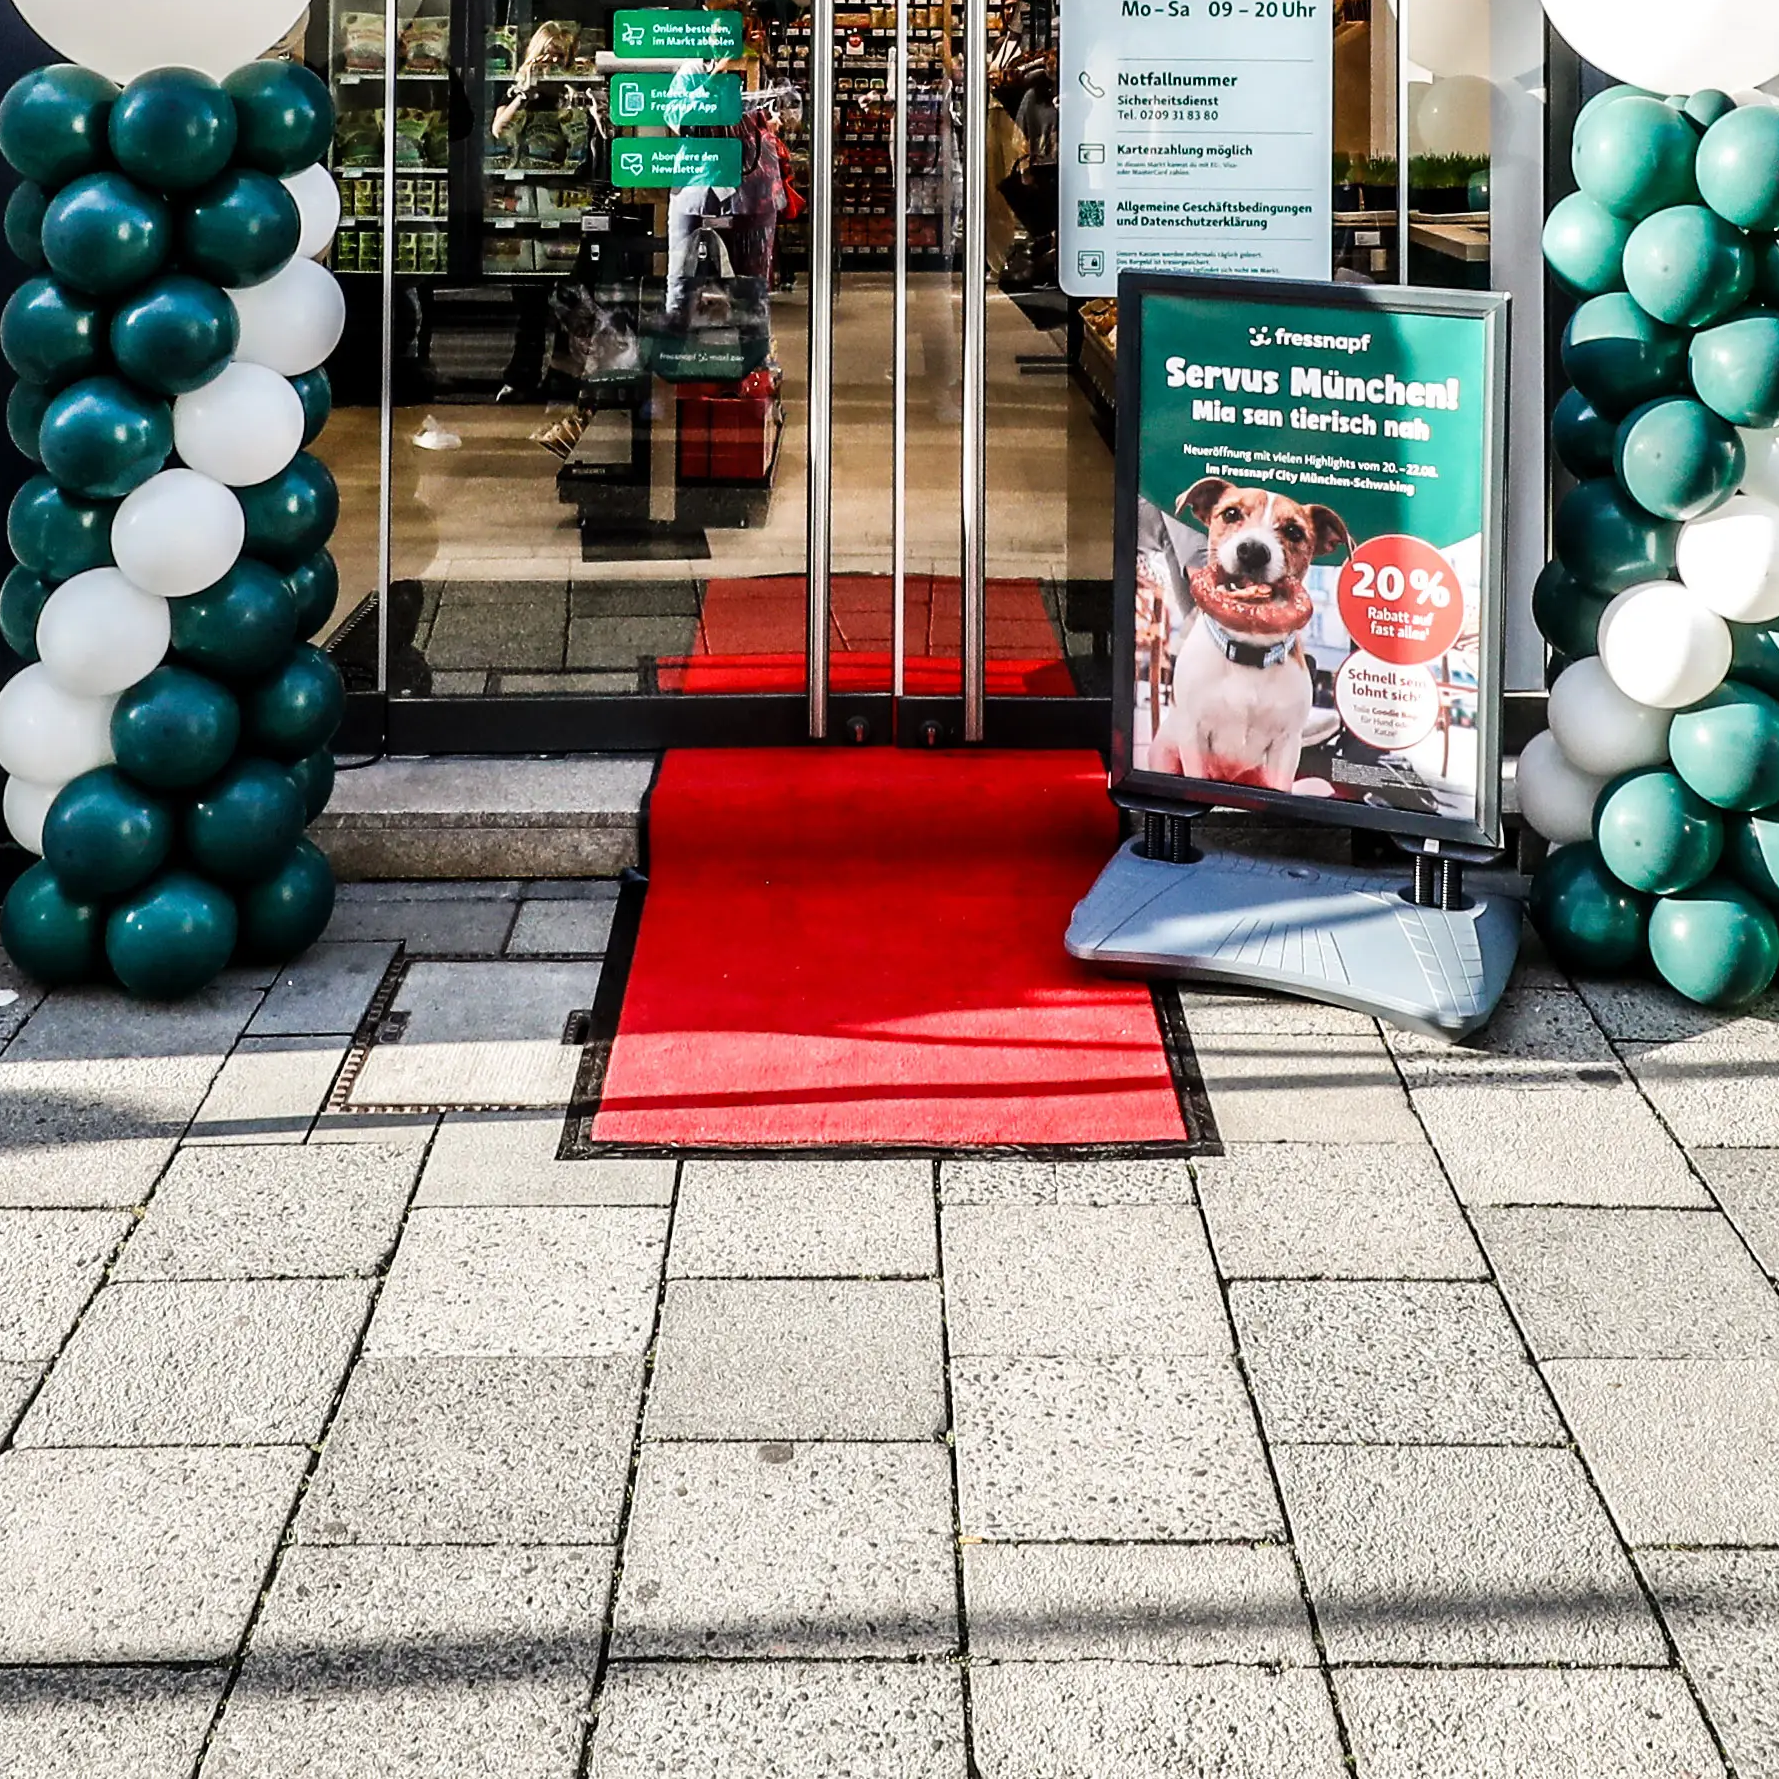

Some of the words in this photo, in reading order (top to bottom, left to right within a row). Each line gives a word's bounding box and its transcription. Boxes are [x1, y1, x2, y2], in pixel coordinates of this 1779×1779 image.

[1121, 0, 1152, 18] Mo
[1168, 0, 1190, 18] Sa
[1208, 0, 1233, 18] 09
[1254, 0, 1278, 18] 20
[1282, 0, 1317, 18] Uhr
[652, 23, 684, 34] Online
[652, 36, 665, 46] im
[666, 36, 695, 46] Markt
[1118, 72, 1239, 87] Notfallnummer
[698, 102, 717, 113] App
[1118, 94, 1219, 106] Sicherheitsdienst
[1118, 109, 1137, 121] Tel.
[1140, 109, 1169, 121] 0209
[1172, 109, 1184, 121] 31
[1187, 109, 1201, 121] 83
[1203, 109, 1219, 121] 80
[702, 151, 719, 162] den
[1117, 144, 1204, 159] Kartenzahlung
[1206, 144, 1253, 159] möglich
[1117, 202, 1180, 216] Allgemeine
[1182, 202, 1312, 216] Geschäftsbedingungen
[1117, 216, 1138, 226] und
[1141, 216, 1268, 230] Datenschutzerklärung
[1274, 327, 1372, 354] fressnapf
[1165, 356, 1280, 395] Servus
[1289, 366, 1460, 411] München!
[1192, 399, 1236, 424] Mia
[1242, 405, 1284, 428] san
[1290, 406, 1377, 436] tierisch
[1383, 416, 1431, 442] nah
[1183, 443, 1253, 462] Neueröffnung
[1254, 449, 1271, 463] mit
[1272, 450, 1303, 465] vielen
[1304, 453, 1356, 471] Highlights
[1358, 461, 1380, 473] vom
[1222, 464, 1275, 481] Fressnapf
[1275, 469, 1298, 485] City
[1299, 471, 1416, 497] München-Schwabing
[1367, 606, 1410, 625] Rabatt
[1370, 621, 1395, 637] fast
[1348, 668, 1397, 686] Schnell
[1352, 683, 1388, 701] lohnt
